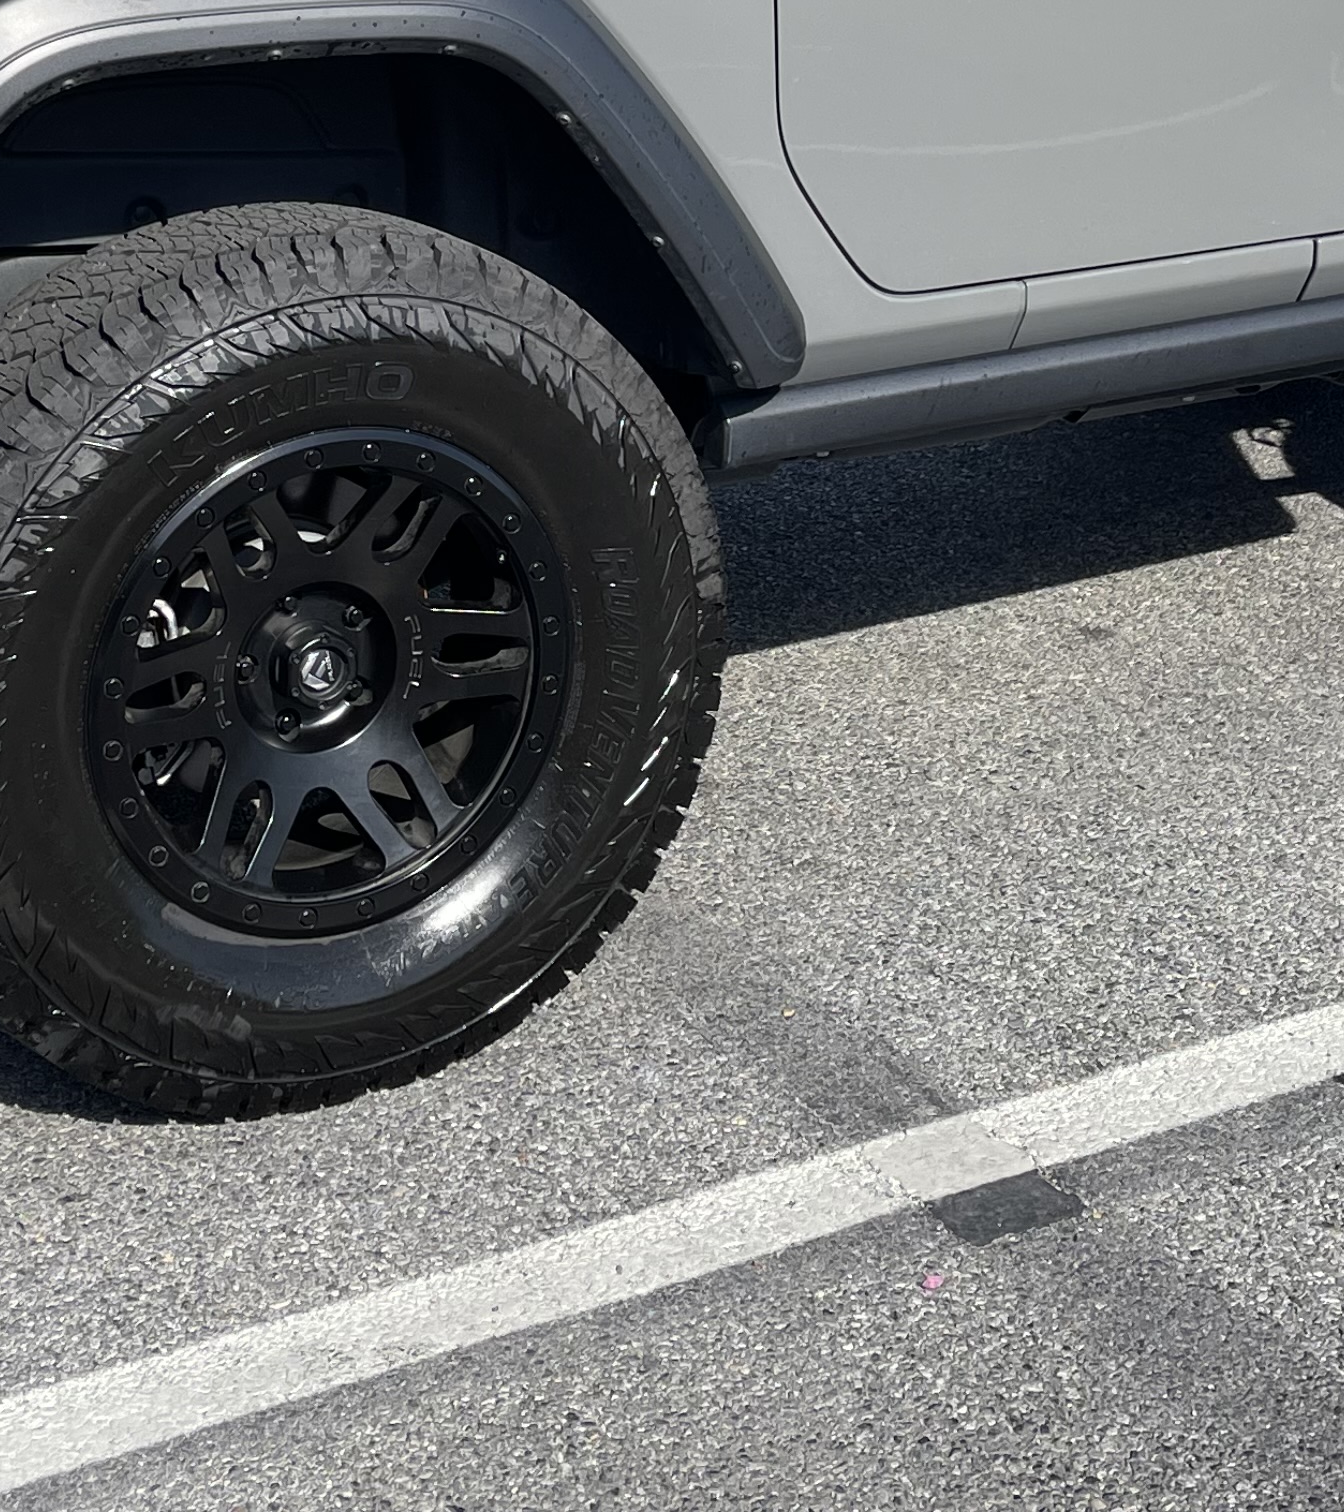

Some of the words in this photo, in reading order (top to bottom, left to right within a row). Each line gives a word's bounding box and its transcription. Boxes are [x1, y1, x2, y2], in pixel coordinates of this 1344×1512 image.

[147, 361, 415, 487] KUMHO
[404, 614, 424, 700] FUEL
[589, 547, 640, 687] ROAD
[213, 641, 233, 730] FUEL
[508, 687, 641, 913] VENTURE
